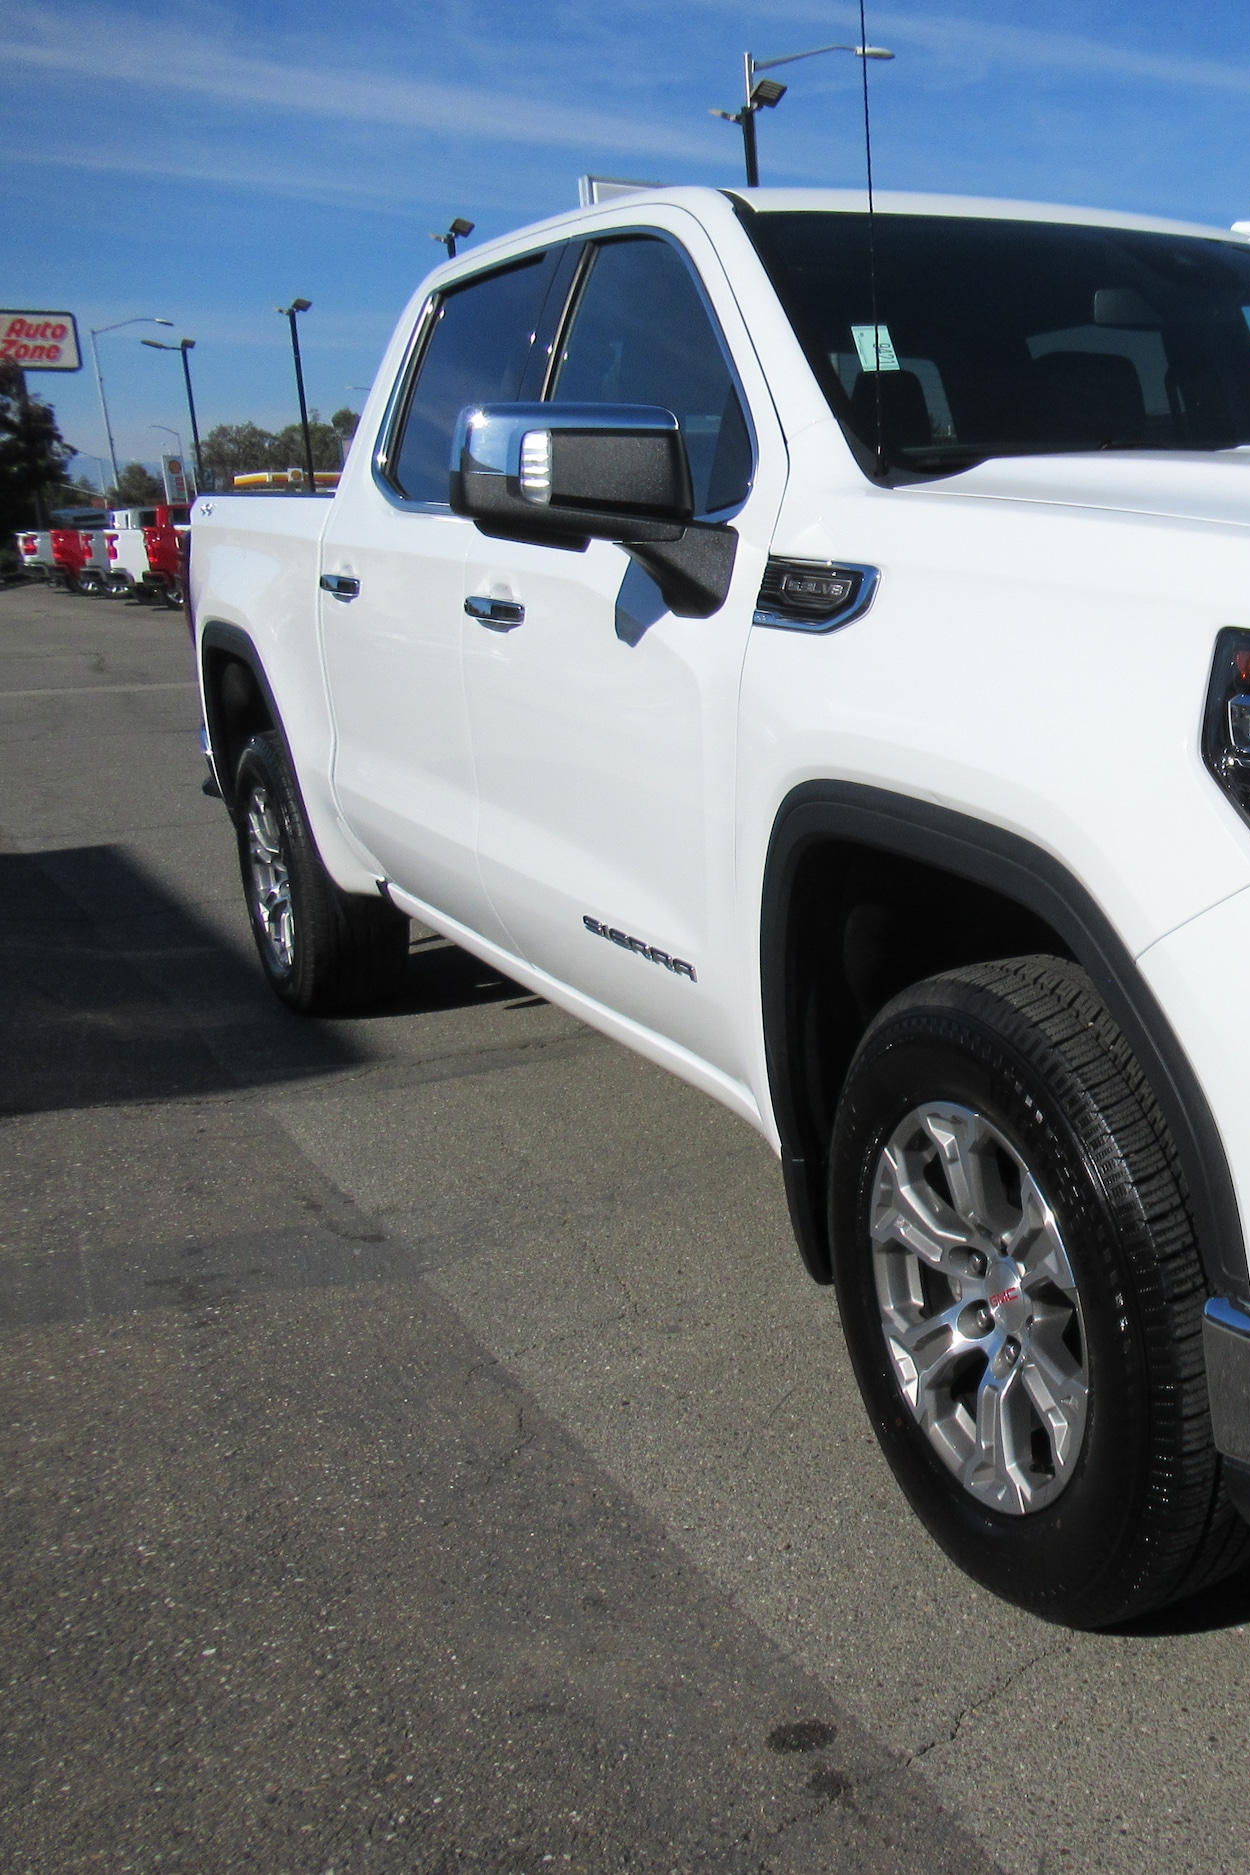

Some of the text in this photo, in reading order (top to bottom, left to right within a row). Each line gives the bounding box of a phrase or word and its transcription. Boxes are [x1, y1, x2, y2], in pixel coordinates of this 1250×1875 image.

[5, 318, 68, 341] Auto
[0, 338, 62, 361] Zone
[582, 914, 698, 983] SIERRA
[989, 1286, 1019, 1308] GMC
